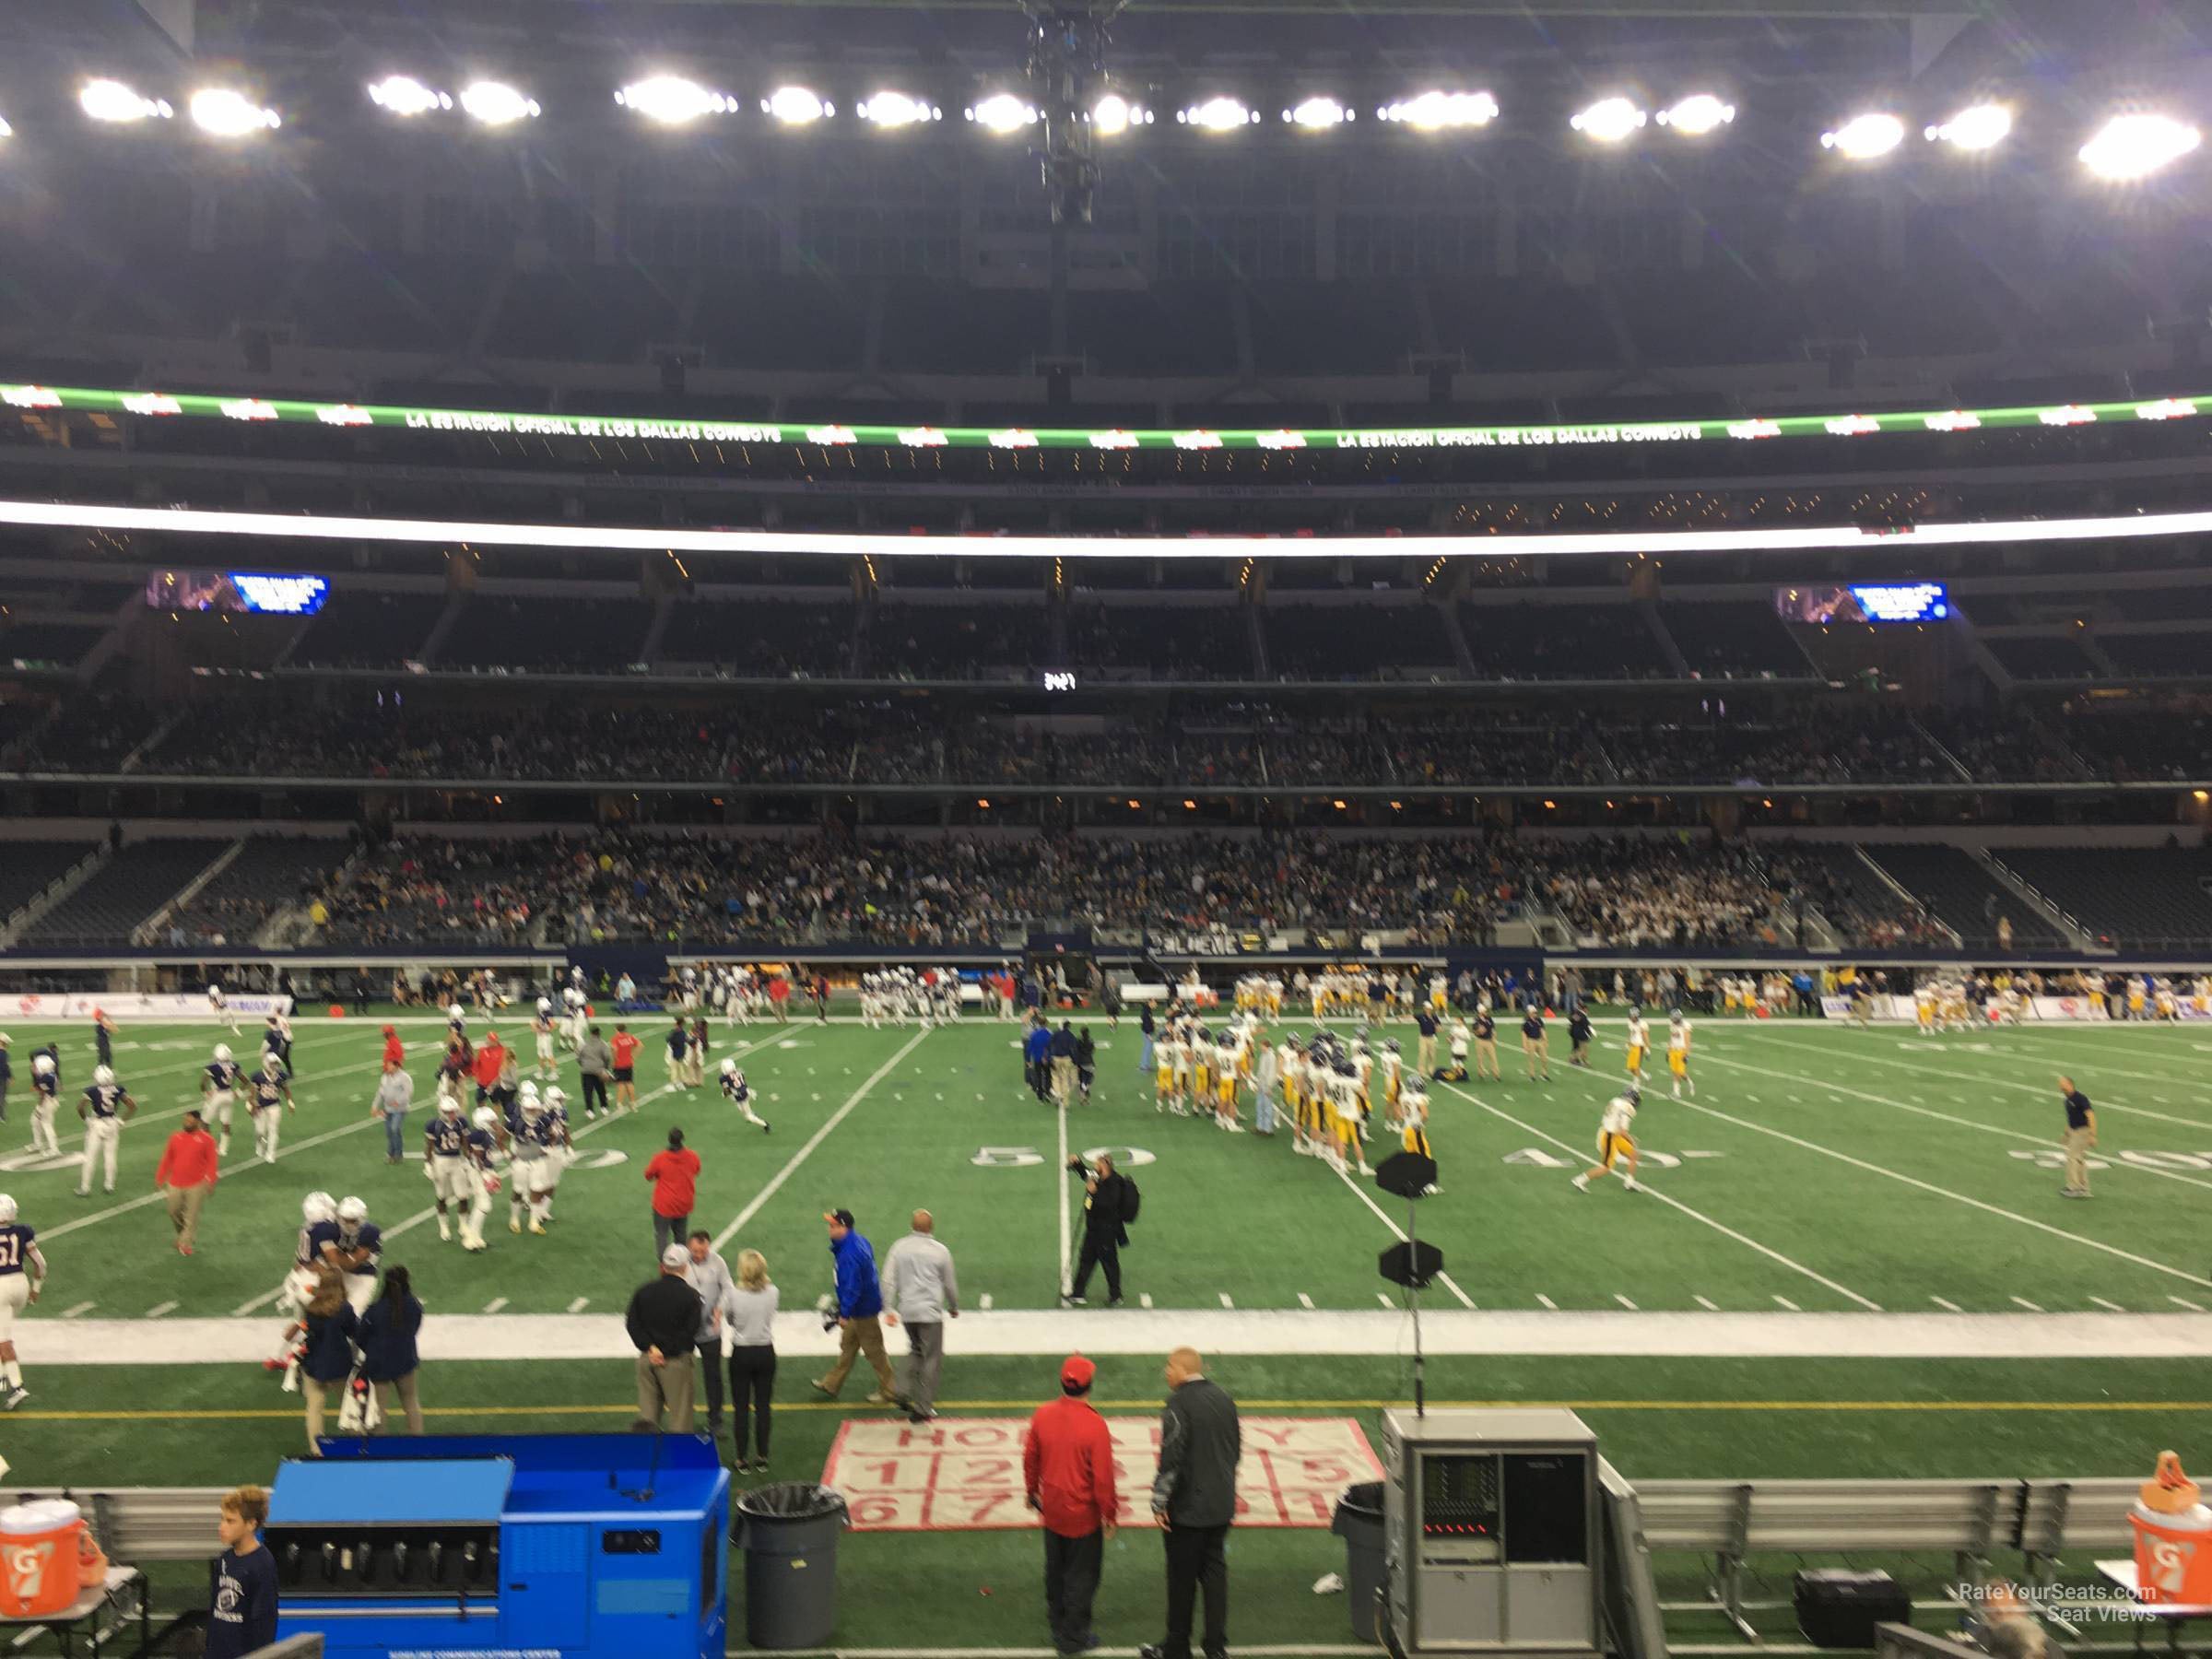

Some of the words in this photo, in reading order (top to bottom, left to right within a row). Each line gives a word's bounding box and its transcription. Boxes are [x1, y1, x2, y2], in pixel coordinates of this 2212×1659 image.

[406, 413, 429, 429] LA
[514, 416, 576, 435] OFICIAL
[579, 419, 600, 436] DE
[604, 420, 636, 438] LOS
[639, 422, 700, 440] DALLAS
[703, 424, 782, 442] COWBOYS
[1336, 432, 1357, 448] LA
[1436, 430, 1496, 447] OFICIAL
[1498, 429, 1520, 445] DE
[1523, 428, 1554, 444] LOS
[1557, 427, 1618, 443] DALLAS
[1621, 424, 1701, 442] COWBOYS
[865, 1461, 899, 1485] 1
[963, 1459, 1013, 1484] 2
[1302, 1458, 1350, 1482] 5
[849, 1497, 900, 1524] 6
[962, 1492, 1013, 1523] 7
[14, 1548, 40, 1575] G
[2153, 1542, 2183, 1569] G
